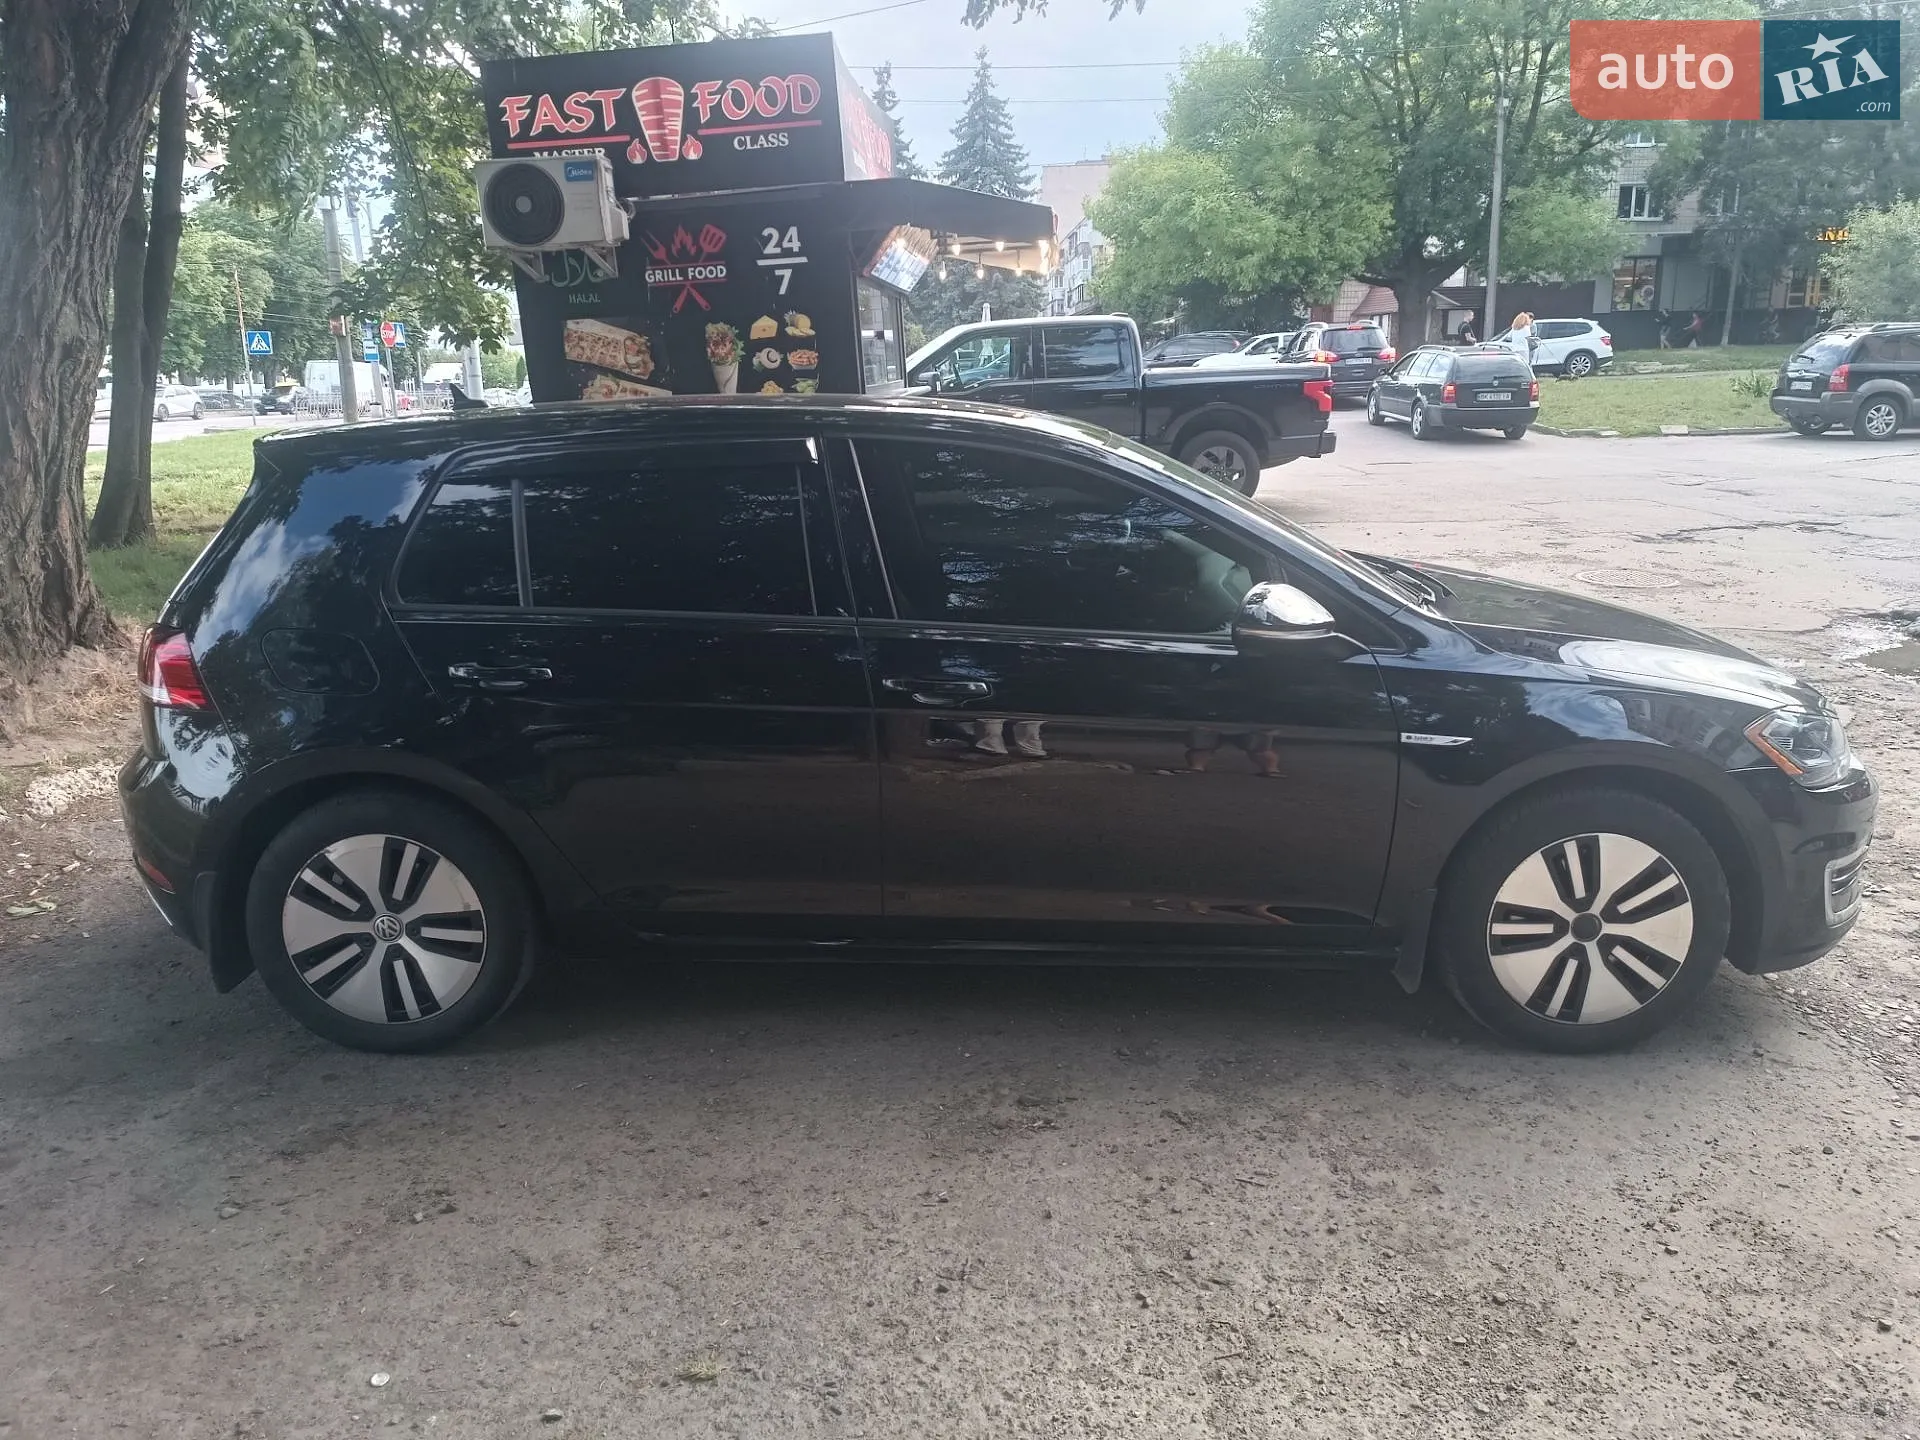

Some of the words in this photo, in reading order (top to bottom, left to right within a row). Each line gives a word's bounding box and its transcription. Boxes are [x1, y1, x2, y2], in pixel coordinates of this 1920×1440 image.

[500, 88, 627, 138] FAST
[691, 74, 822, 124] FOOD
[733, 132, 789, 150] CLASS
[761, 226, 801, 254] 24
[645, 268, 684, 283] GRILL
[688, 265, 727, 280] FOOD
[775, 268, 792, 295] 7
[568, 293, 600, 304] HALAL
